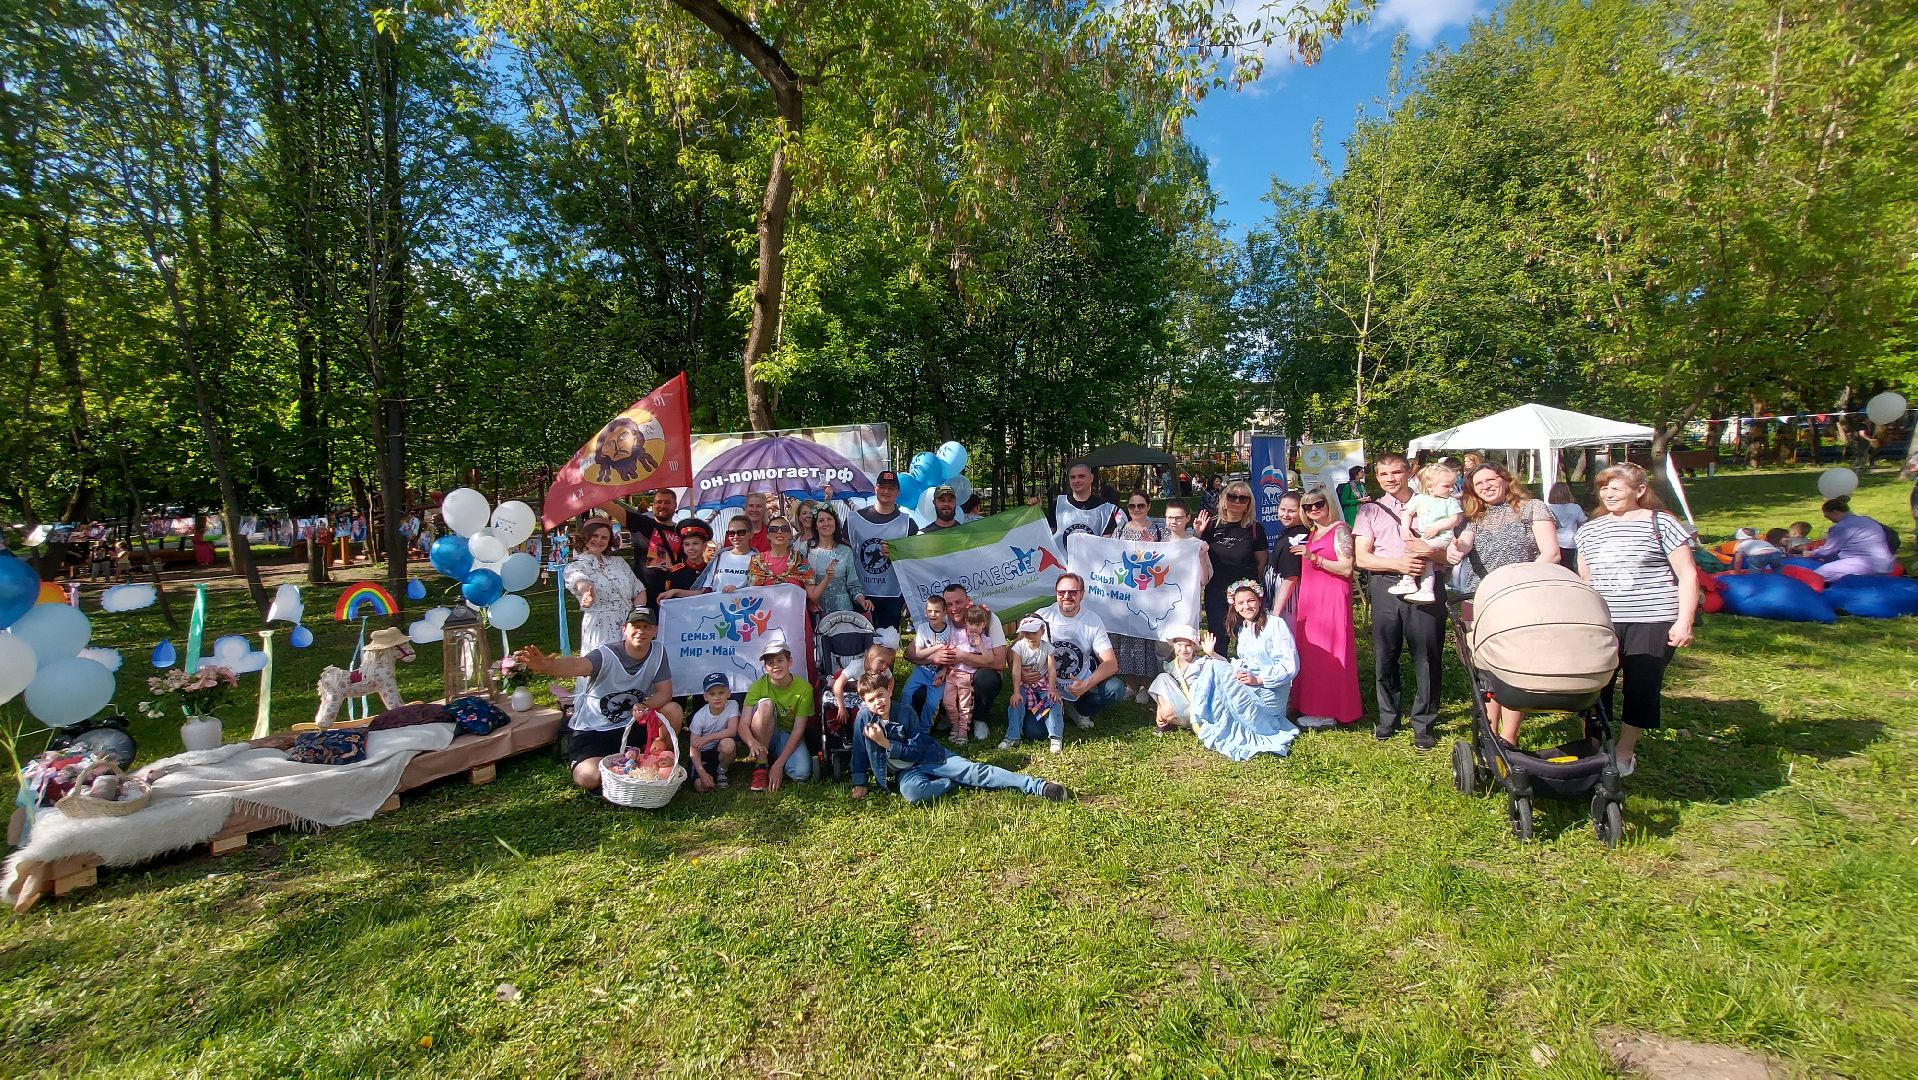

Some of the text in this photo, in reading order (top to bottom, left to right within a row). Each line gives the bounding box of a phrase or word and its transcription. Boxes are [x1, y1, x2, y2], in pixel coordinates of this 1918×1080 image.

[1262, 506, 1278, 515] ЕДИН
[1262, 514, 1279, 522] РОСС
[958, 557, 1036, 594] ВМЕСТЕ
[681, 632, 716, 642] Семья
[680, 645, 736, 657] Мир Май
